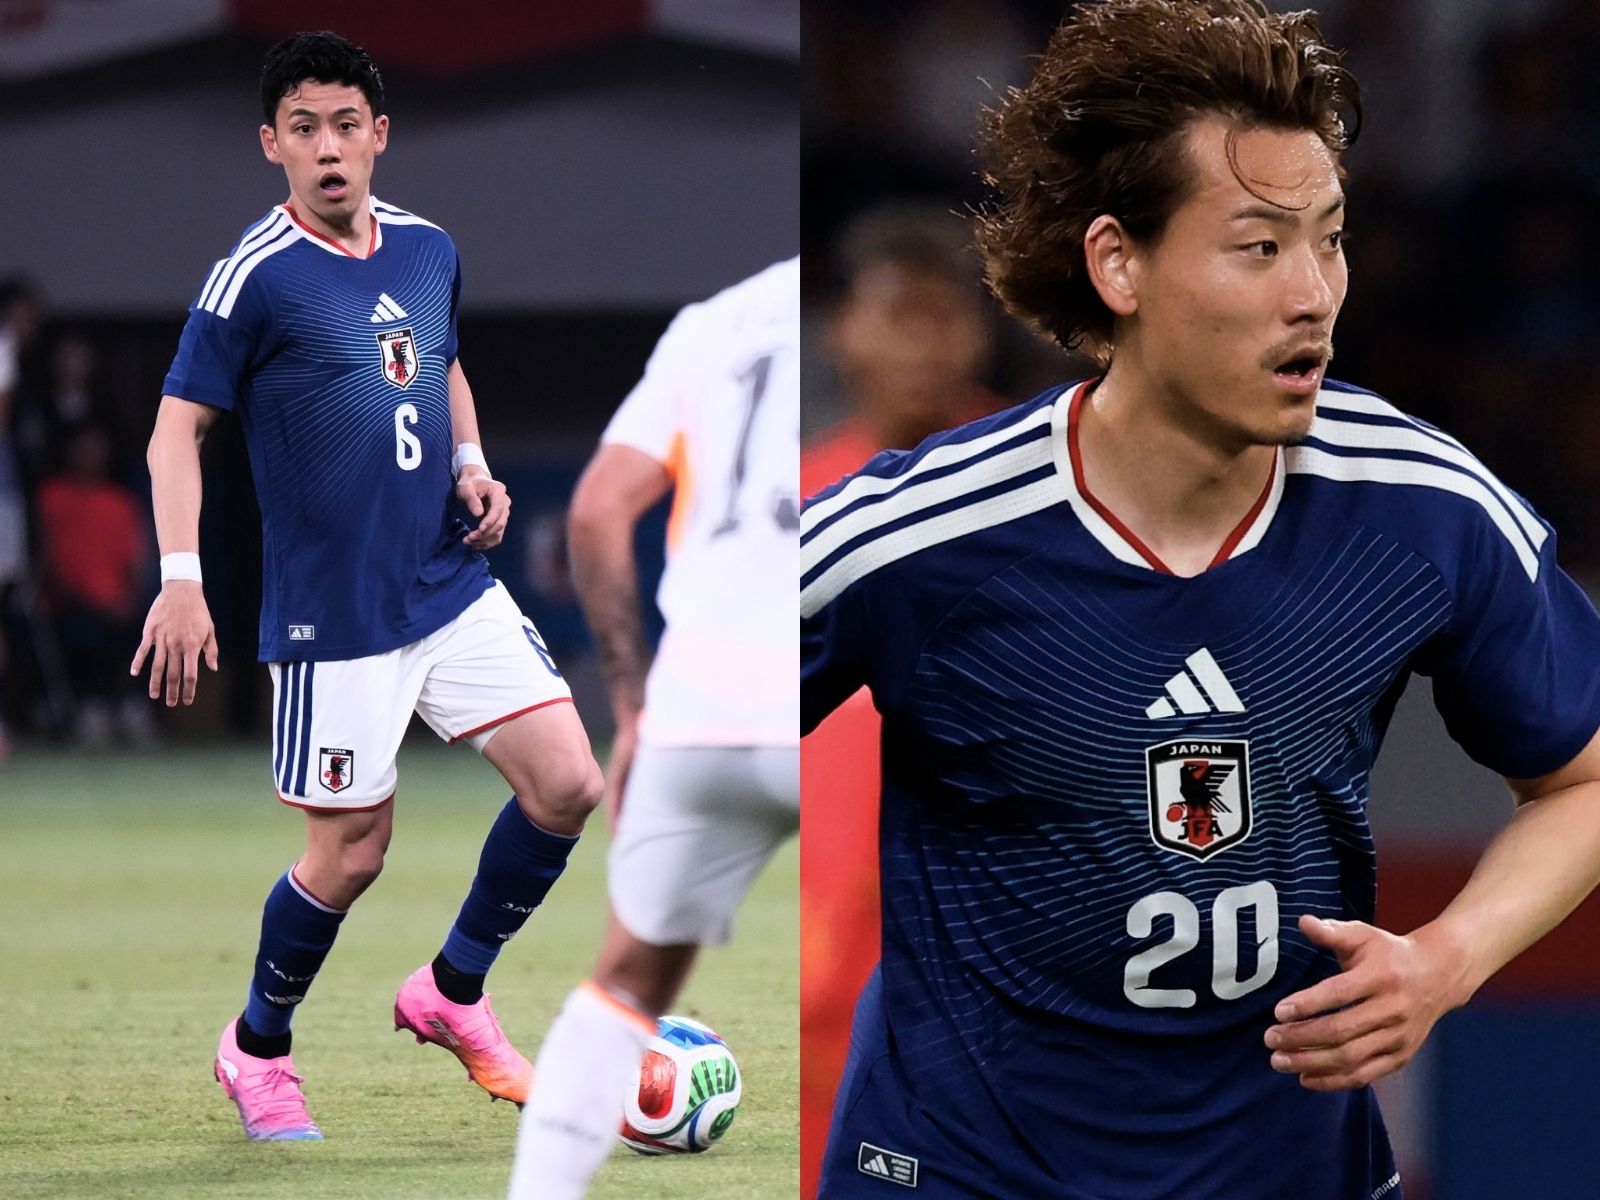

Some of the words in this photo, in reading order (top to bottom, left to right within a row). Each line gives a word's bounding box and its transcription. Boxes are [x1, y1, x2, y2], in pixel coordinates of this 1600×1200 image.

[395, 403, 422, 471] 6
[1169, 744, 1222, 756] JAPAN
[1177, 819, 1224, 840] JFA
[1123, 880, 1280, 1009] 20
